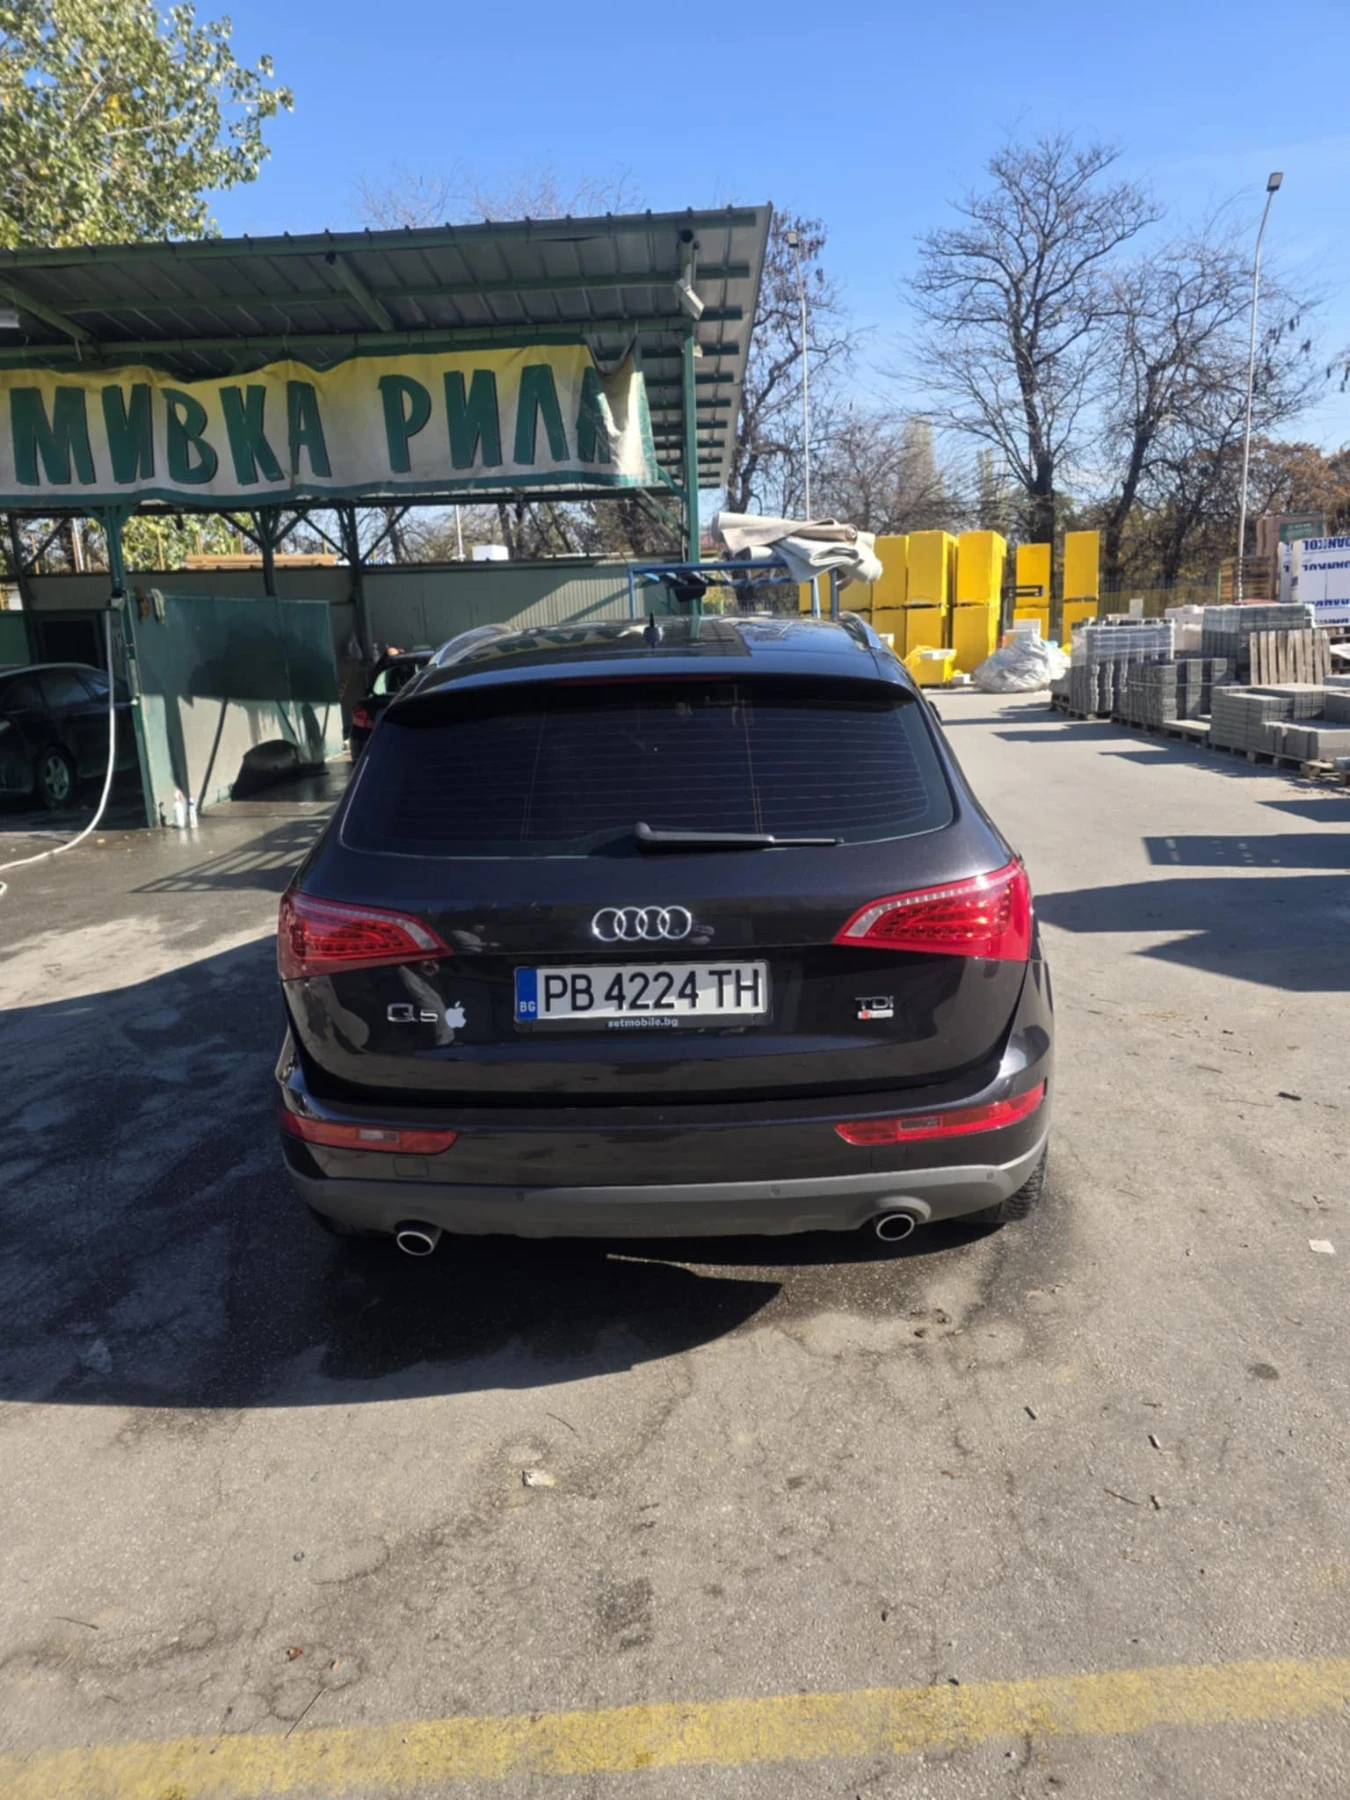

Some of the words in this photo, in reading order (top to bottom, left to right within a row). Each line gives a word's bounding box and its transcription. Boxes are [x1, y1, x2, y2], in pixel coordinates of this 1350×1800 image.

[9, 380, 333, 486] МИВКА
[378, 363, 611, 473] РИЛА
[544, 973, 595, 1012] PB
[604, 971, 699, 1011] 4224
[709, 968, 760, 1008] TH
[387, 1003, 439, 1022] Q5
[519, 1001, 537, 1013] BG
